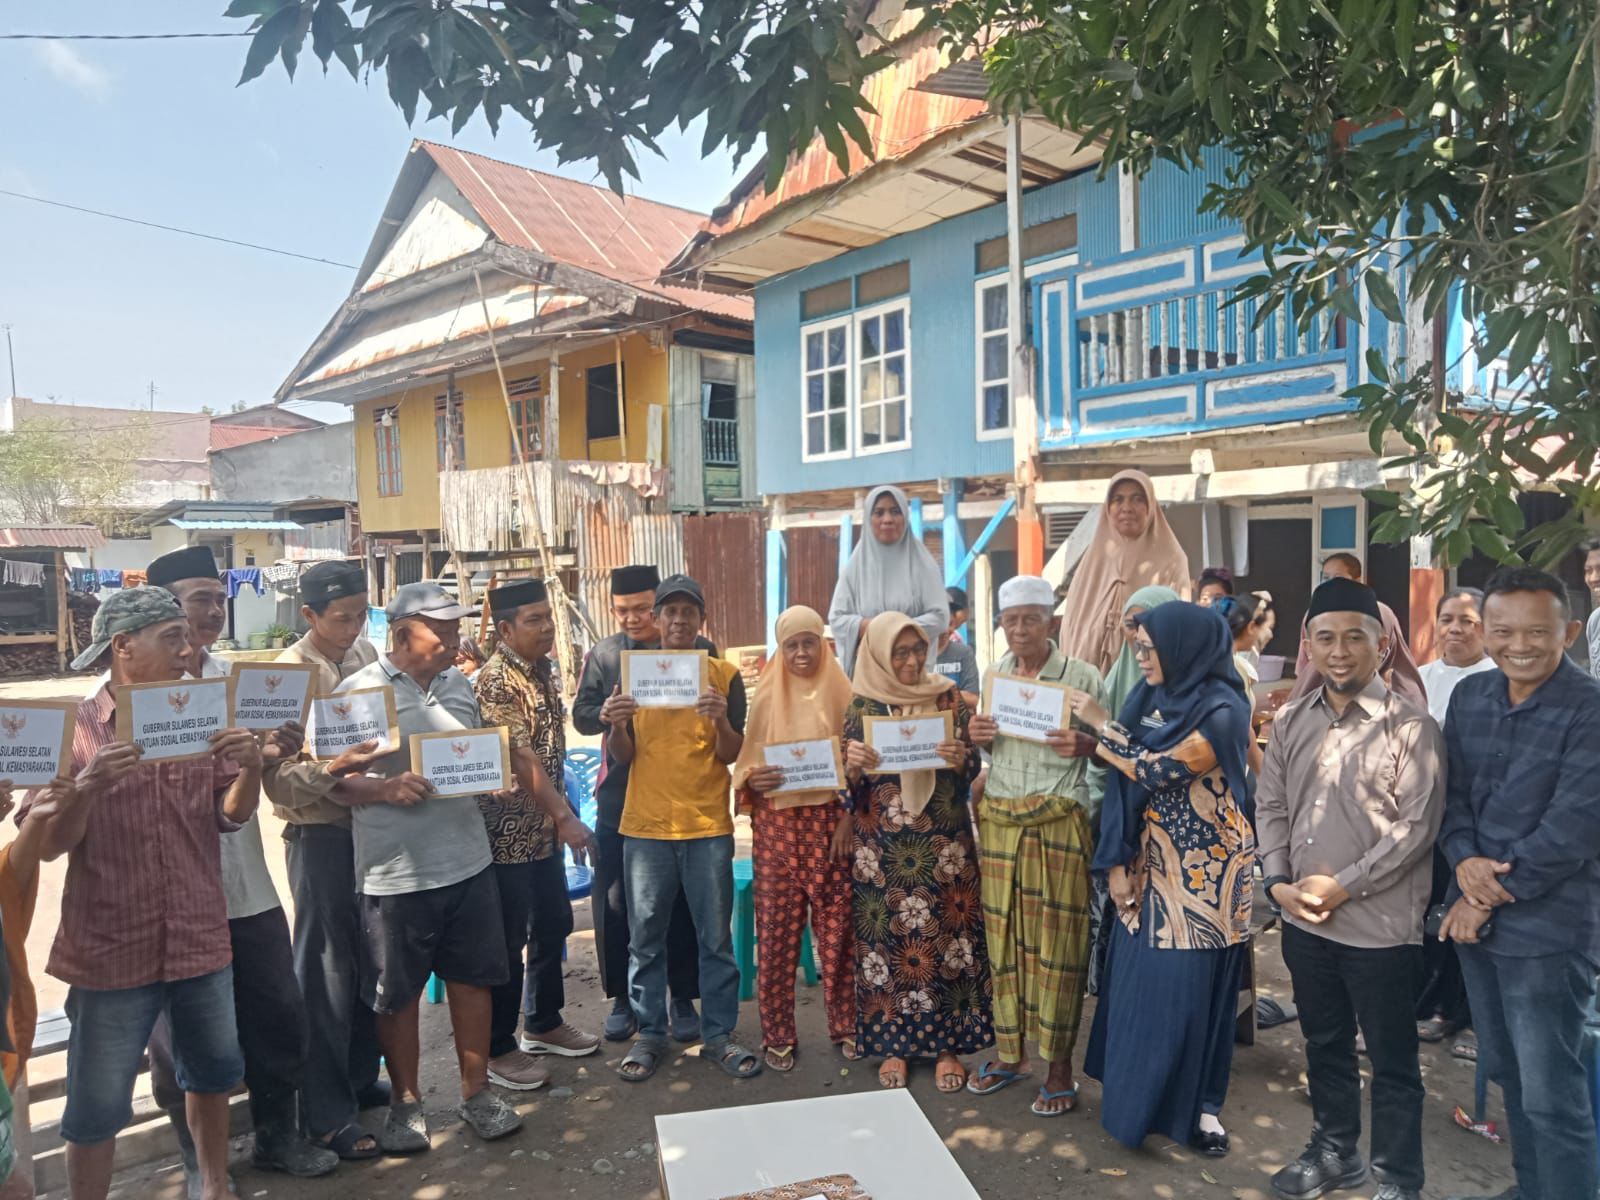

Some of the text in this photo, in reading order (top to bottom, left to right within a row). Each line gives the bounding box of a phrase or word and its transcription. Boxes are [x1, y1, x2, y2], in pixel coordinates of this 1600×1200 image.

[143, 716, 218, 734] GUBERNUR SULAWESI SELATAN
[359, 720, 379, 731] SELATAN
[159, 733, 179, 746] SOSIAL
[28, 746, 51, 757] SELATAN
[6, 761, 56, 773] KEMASYARAKATAN
[432, 764, 455, 775] GUBERNUR
[476, 761, 494, 772] SELATAN
